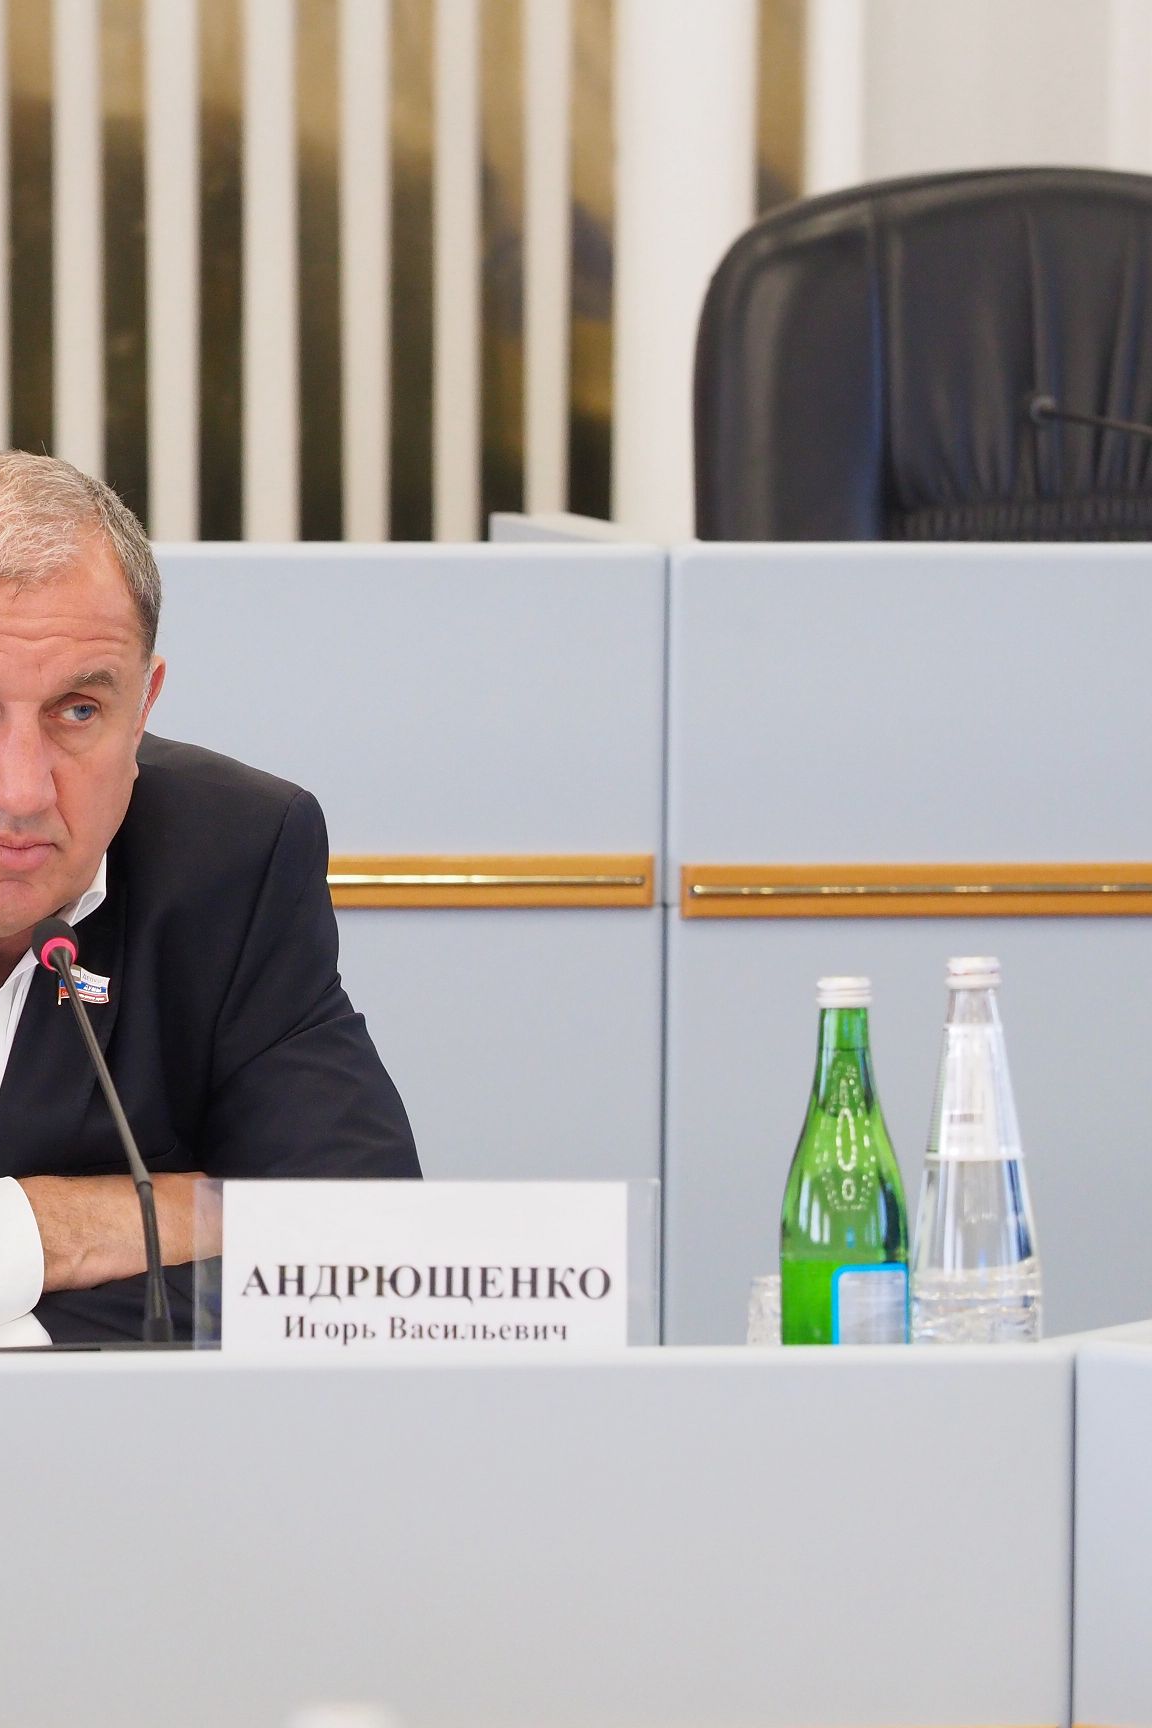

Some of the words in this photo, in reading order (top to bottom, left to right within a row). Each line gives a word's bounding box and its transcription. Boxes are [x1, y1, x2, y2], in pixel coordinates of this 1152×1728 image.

[241, 1264, 612, 1303] АНДРЮЩЕНКО
[284, 1314, 377, 1345] Игорь
[388, 1316, 568, 1341] Васильевич
